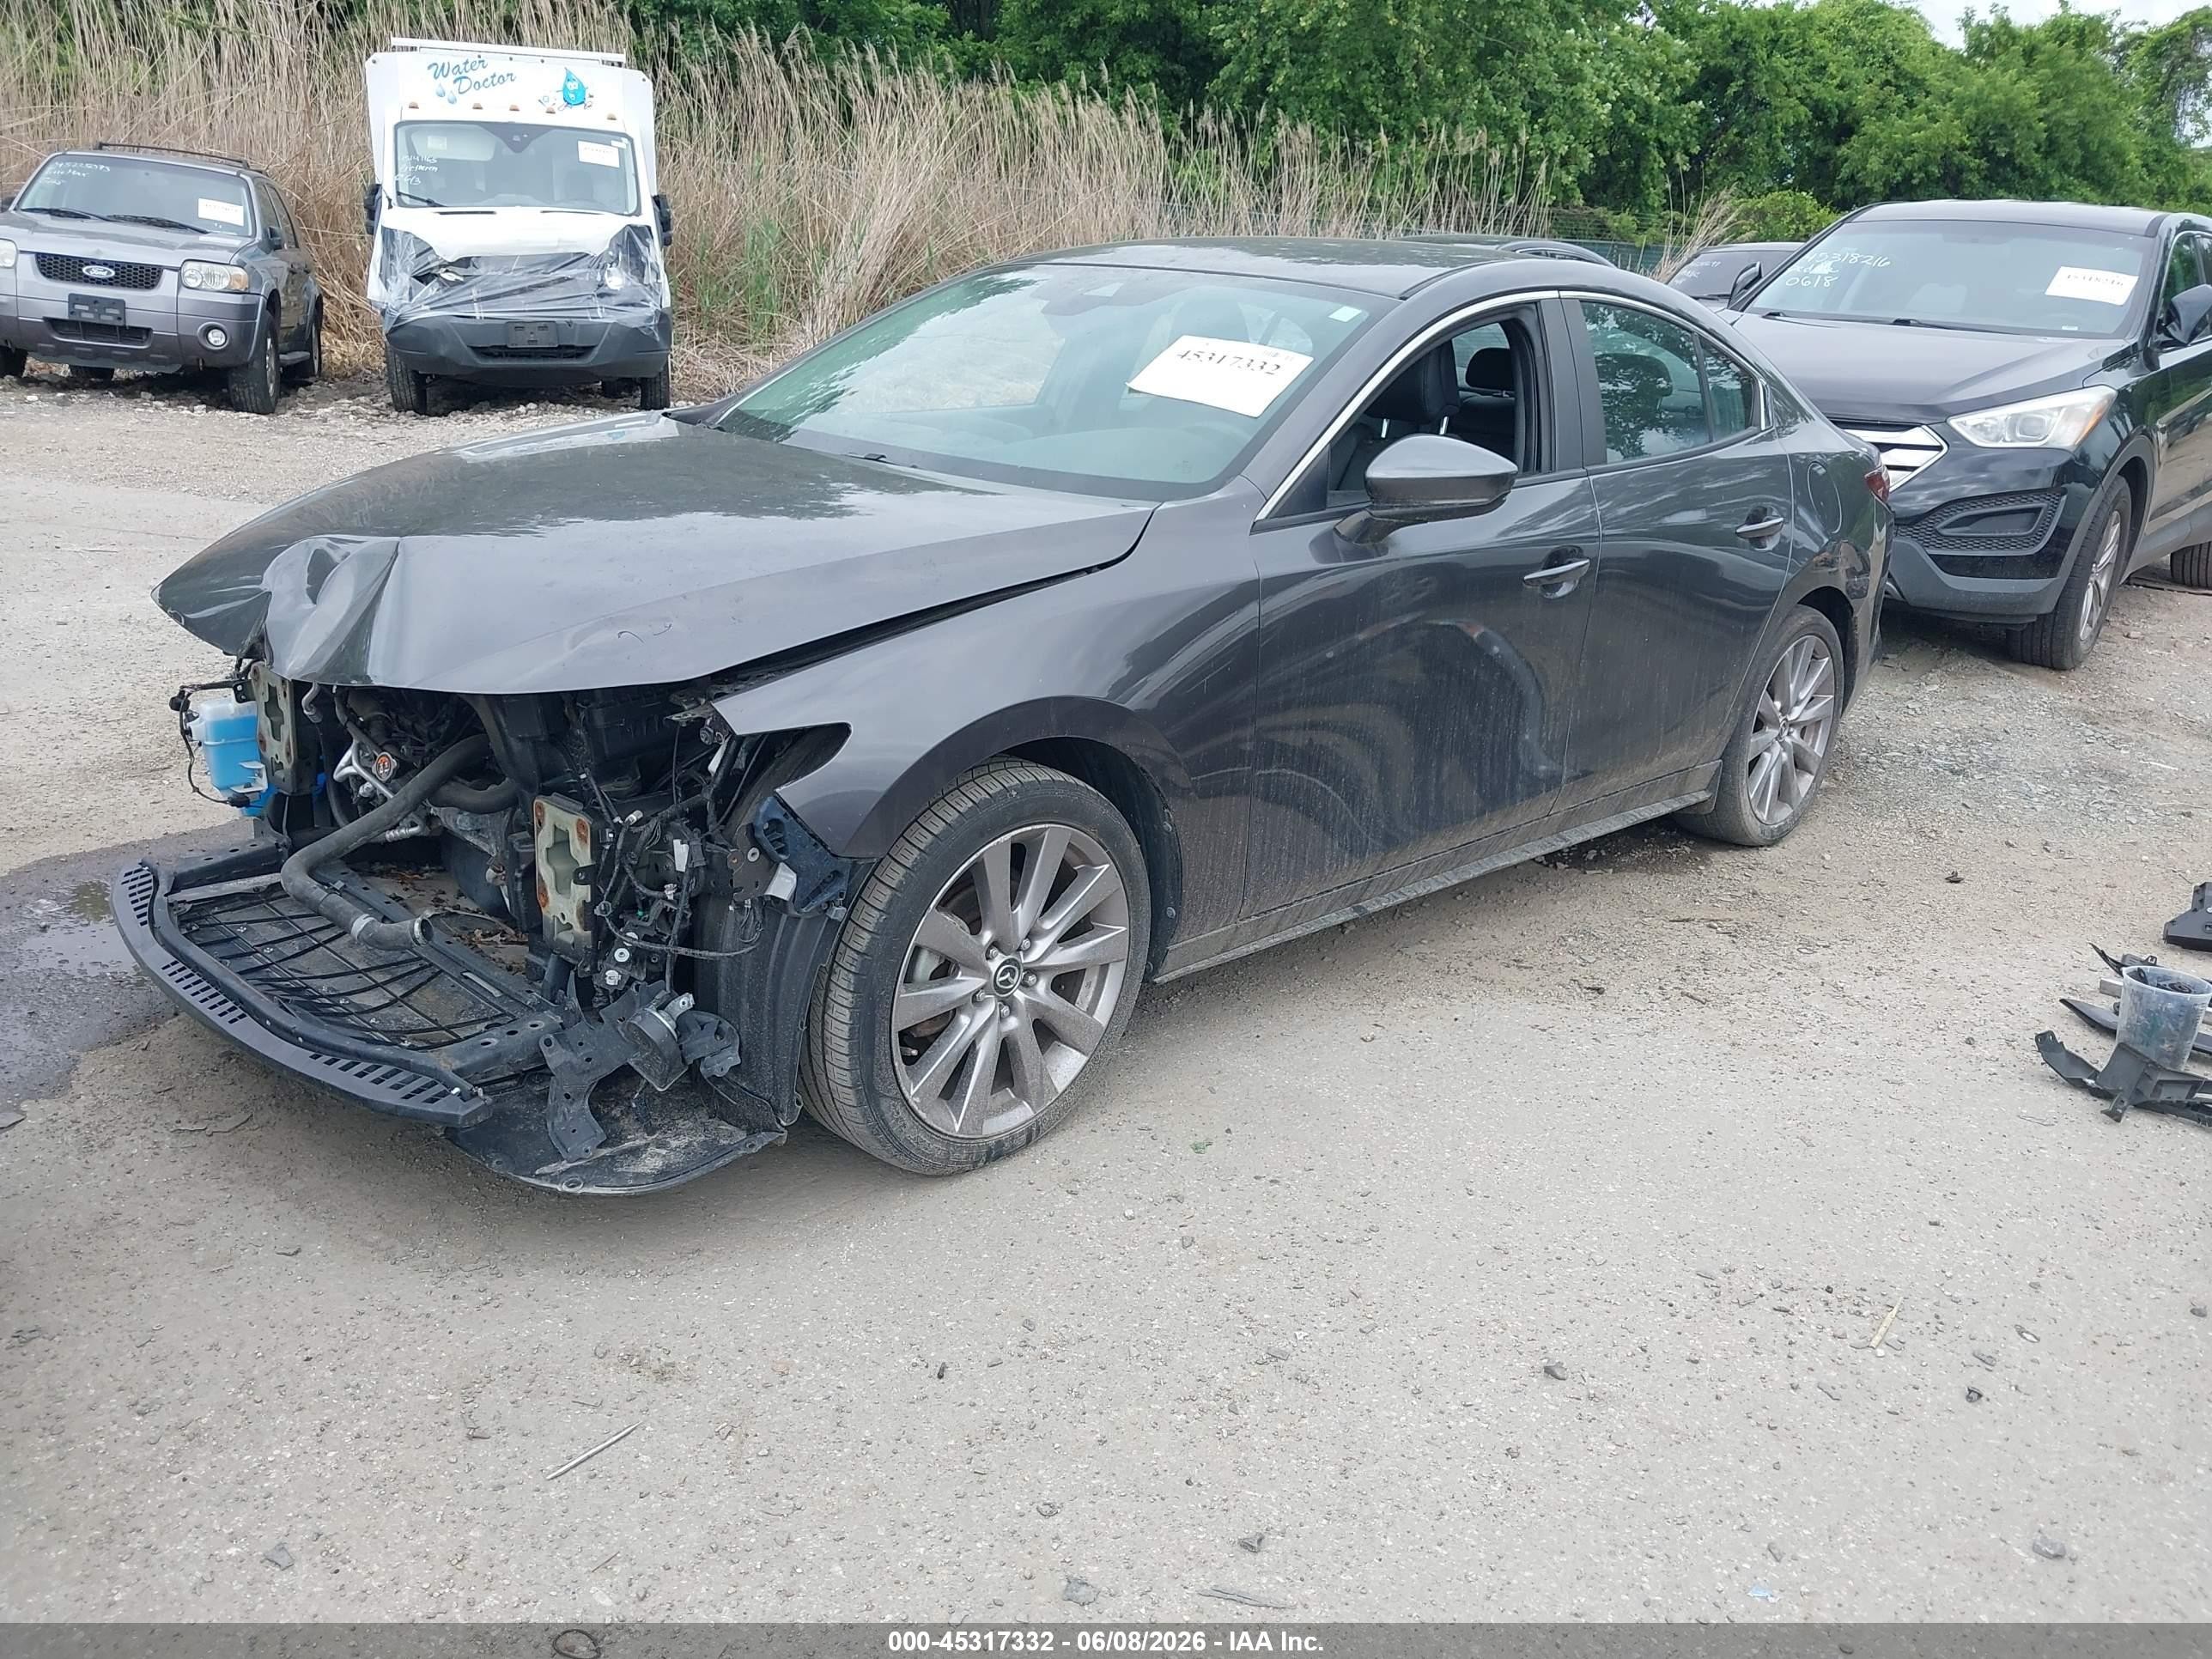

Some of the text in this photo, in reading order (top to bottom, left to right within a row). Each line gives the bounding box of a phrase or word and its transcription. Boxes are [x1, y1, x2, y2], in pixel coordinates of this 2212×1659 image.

[427, 59, 489, 80] Water
[453, 72, 517, 94] Doctor
[1786, 276, 1838, 287] 0618
[1176, 349, 1281, 375] 45317332
